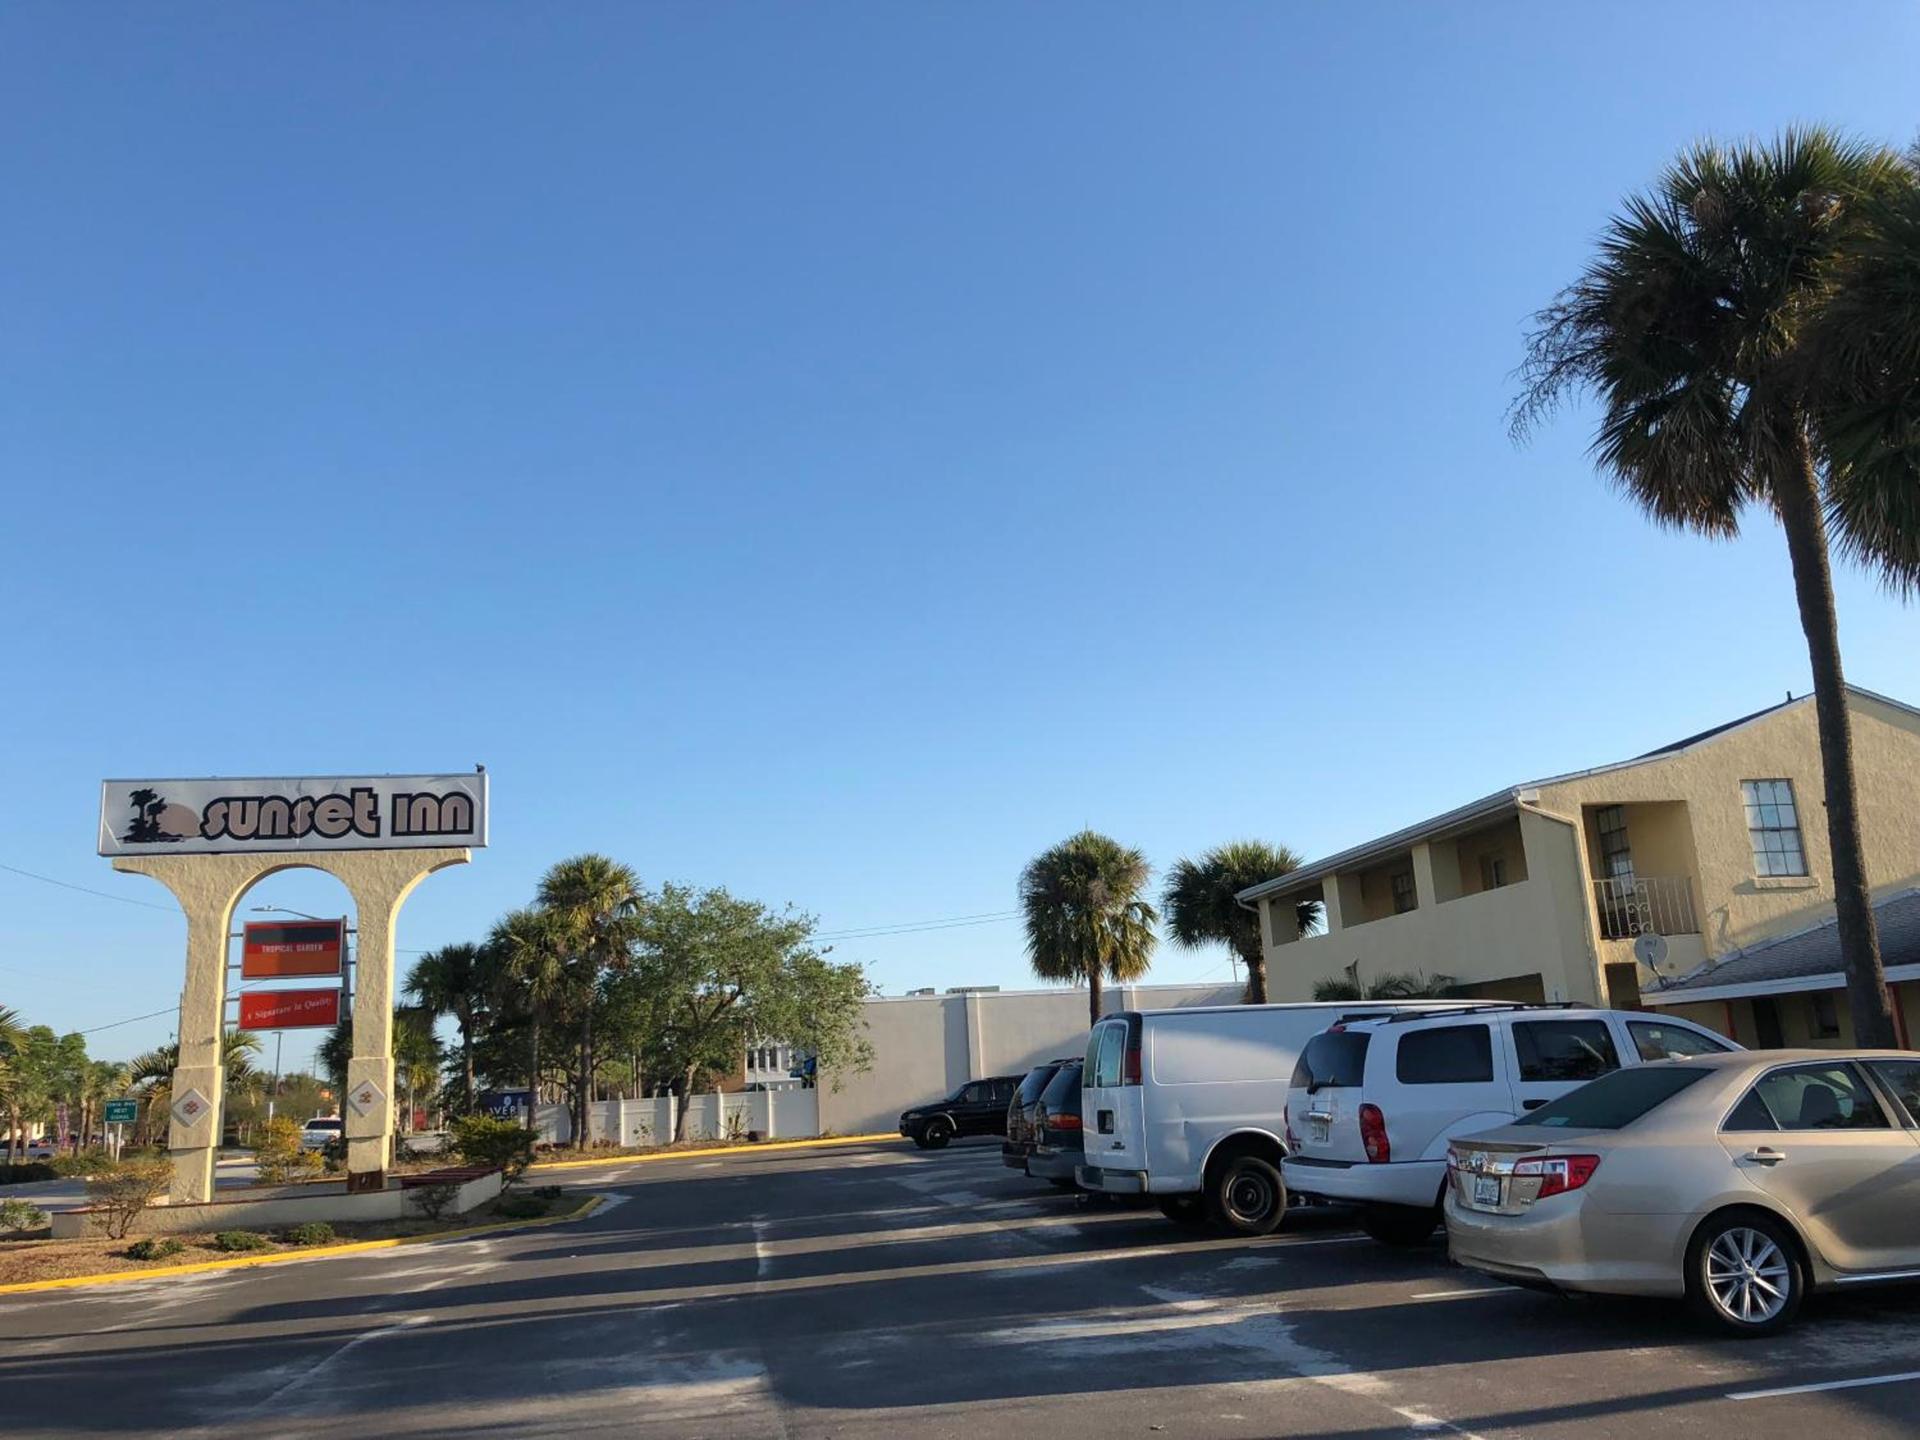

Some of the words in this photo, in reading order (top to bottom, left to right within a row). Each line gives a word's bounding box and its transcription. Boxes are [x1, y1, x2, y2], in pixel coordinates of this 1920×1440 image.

[199, 787, 380, 840] sunset
[391, 791, 474, 837] inn
[262, 944, 293, 953] TROPICAL
[296, 943, 324, 953] GARDEN
[254, 1006, 292, 1020] Signature
